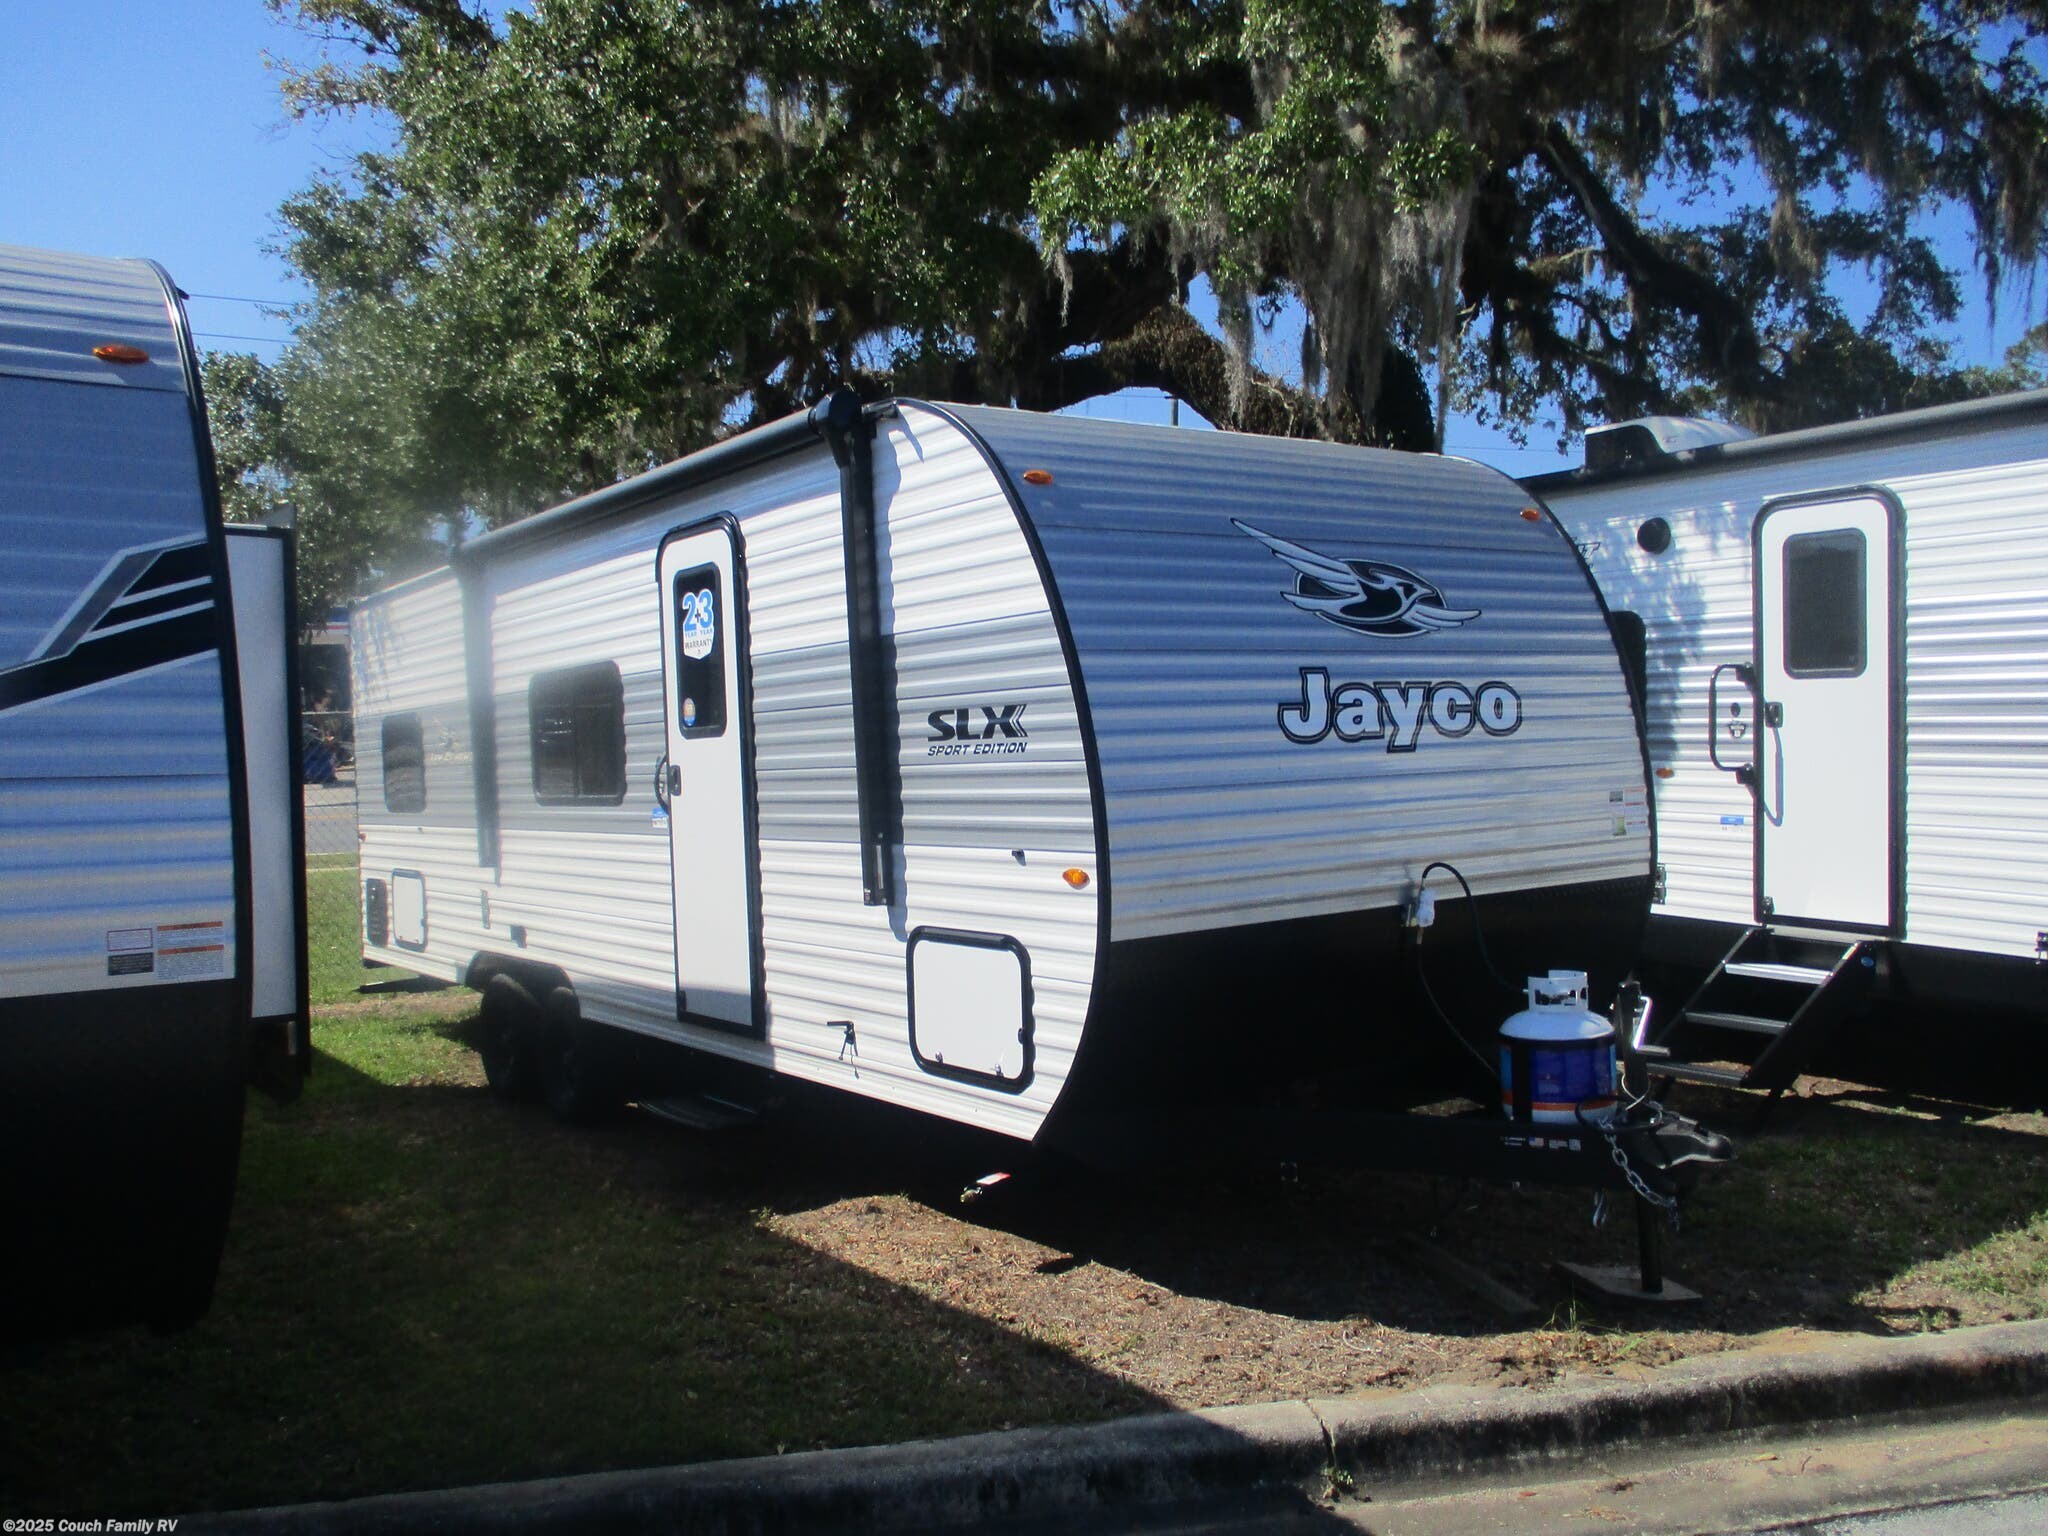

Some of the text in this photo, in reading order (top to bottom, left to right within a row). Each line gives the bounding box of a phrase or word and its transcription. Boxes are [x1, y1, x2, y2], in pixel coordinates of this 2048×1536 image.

[928, 704, 1028, 741] SLX
[1277, 666, 1523, 753] Jayco
[928, 742, 1027, 757] SPORT EDITION
